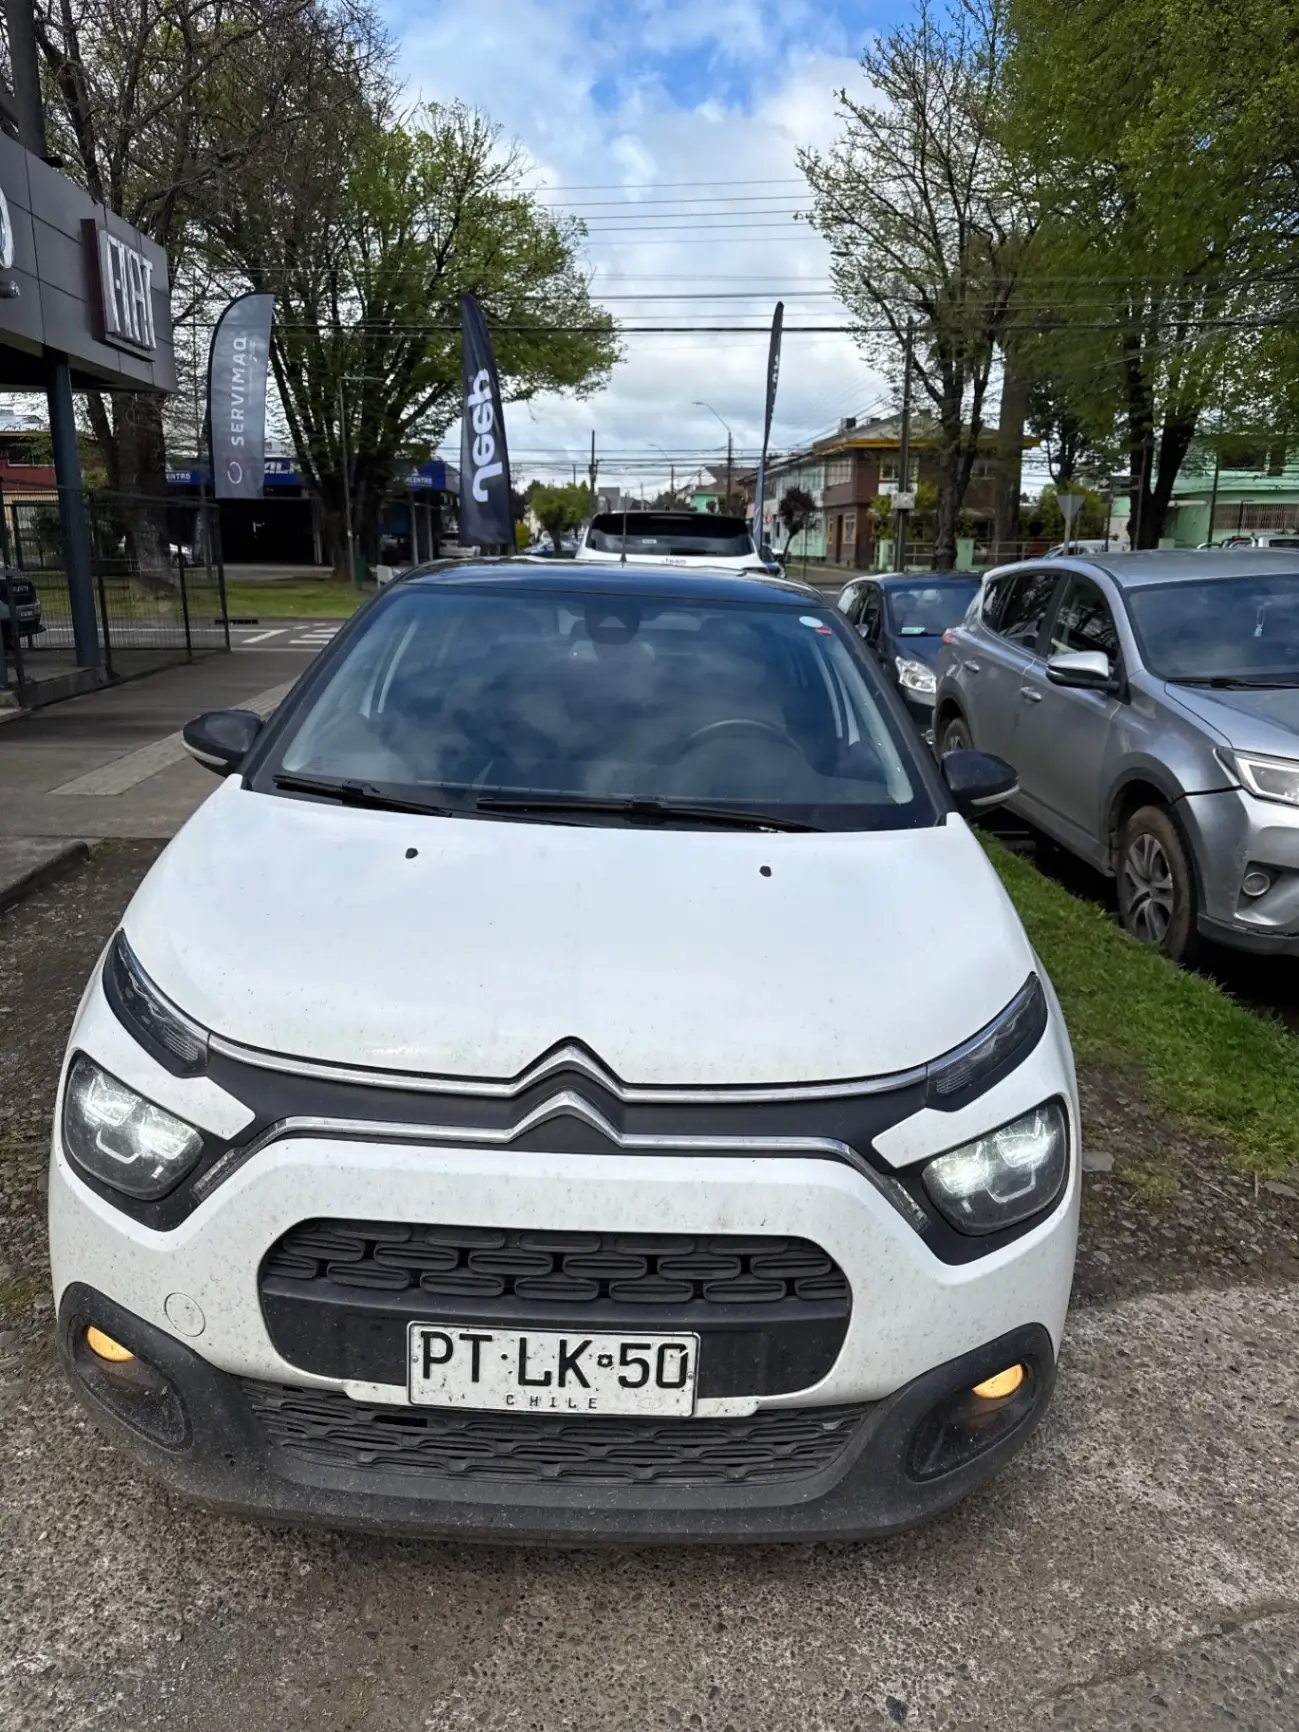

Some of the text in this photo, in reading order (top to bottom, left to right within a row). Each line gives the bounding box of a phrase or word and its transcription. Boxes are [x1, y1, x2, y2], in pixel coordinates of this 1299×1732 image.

[104, 232, 157, 350] FIAT
[230, 335, 248, 447] SERVIMAQ
[505, 1394, 598, 1410] CHILE
